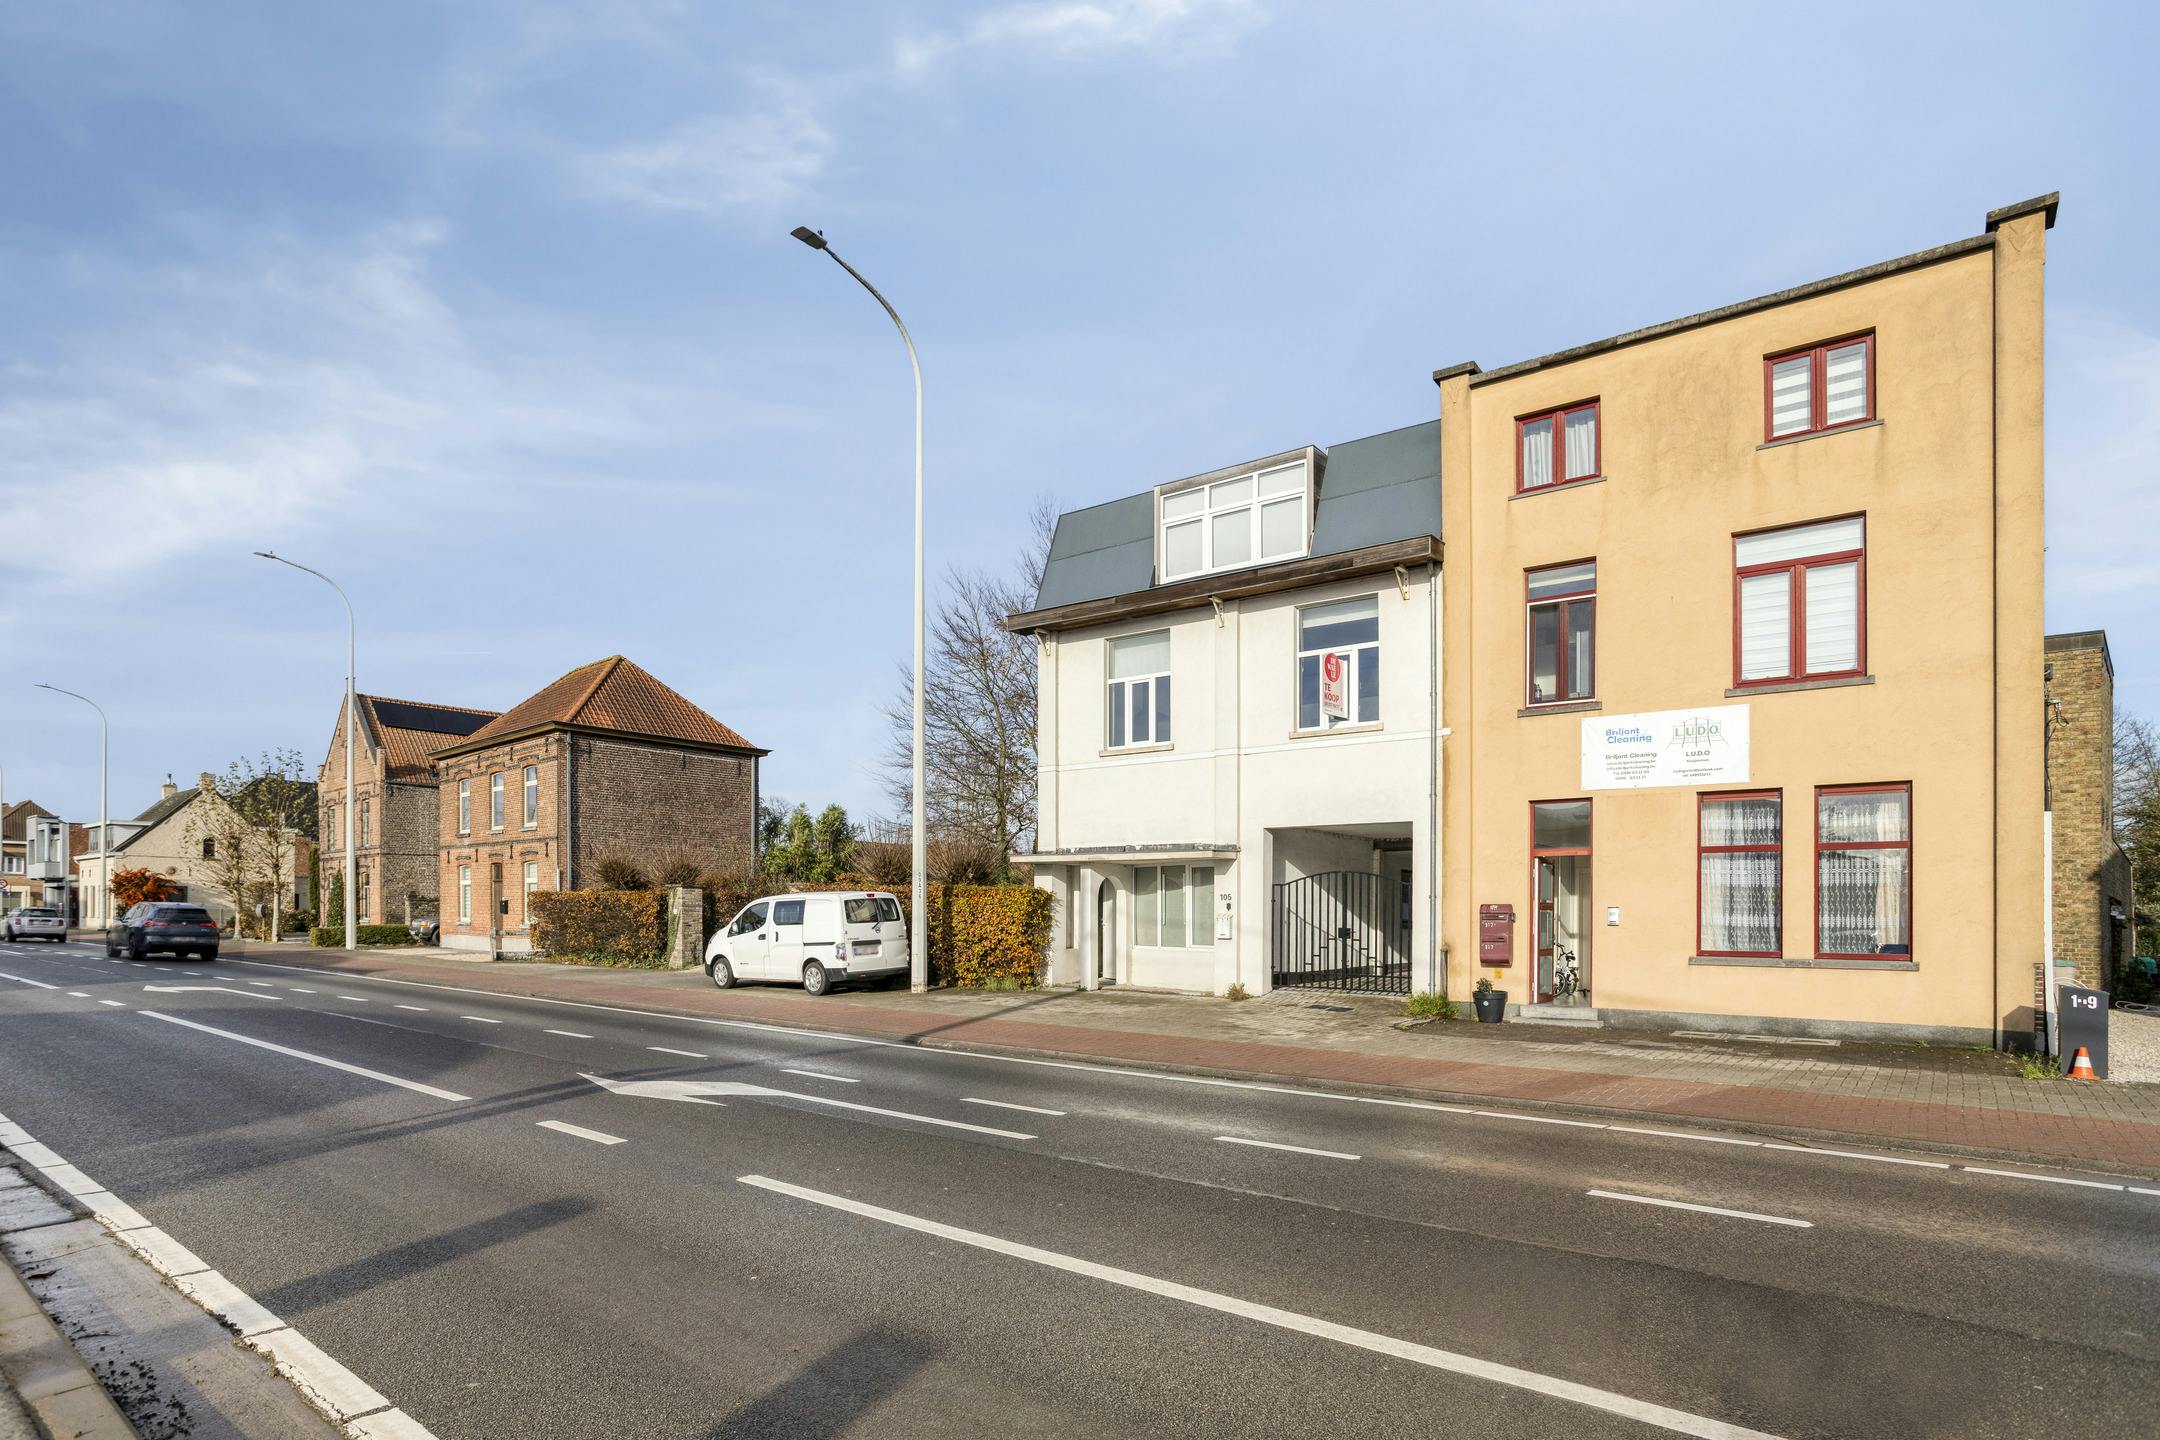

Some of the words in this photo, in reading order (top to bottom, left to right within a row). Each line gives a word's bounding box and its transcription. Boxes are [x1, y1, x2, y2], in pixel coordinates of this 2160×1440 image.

[1325, 683, 1331, 692] TE
[1325, 693, 1340, 703] KOOP
[1605, 727, 1640, 737] Briljant
[1606, 735, 1652, 744] Cleaning
[1220, 893, 1232, 901] 105
